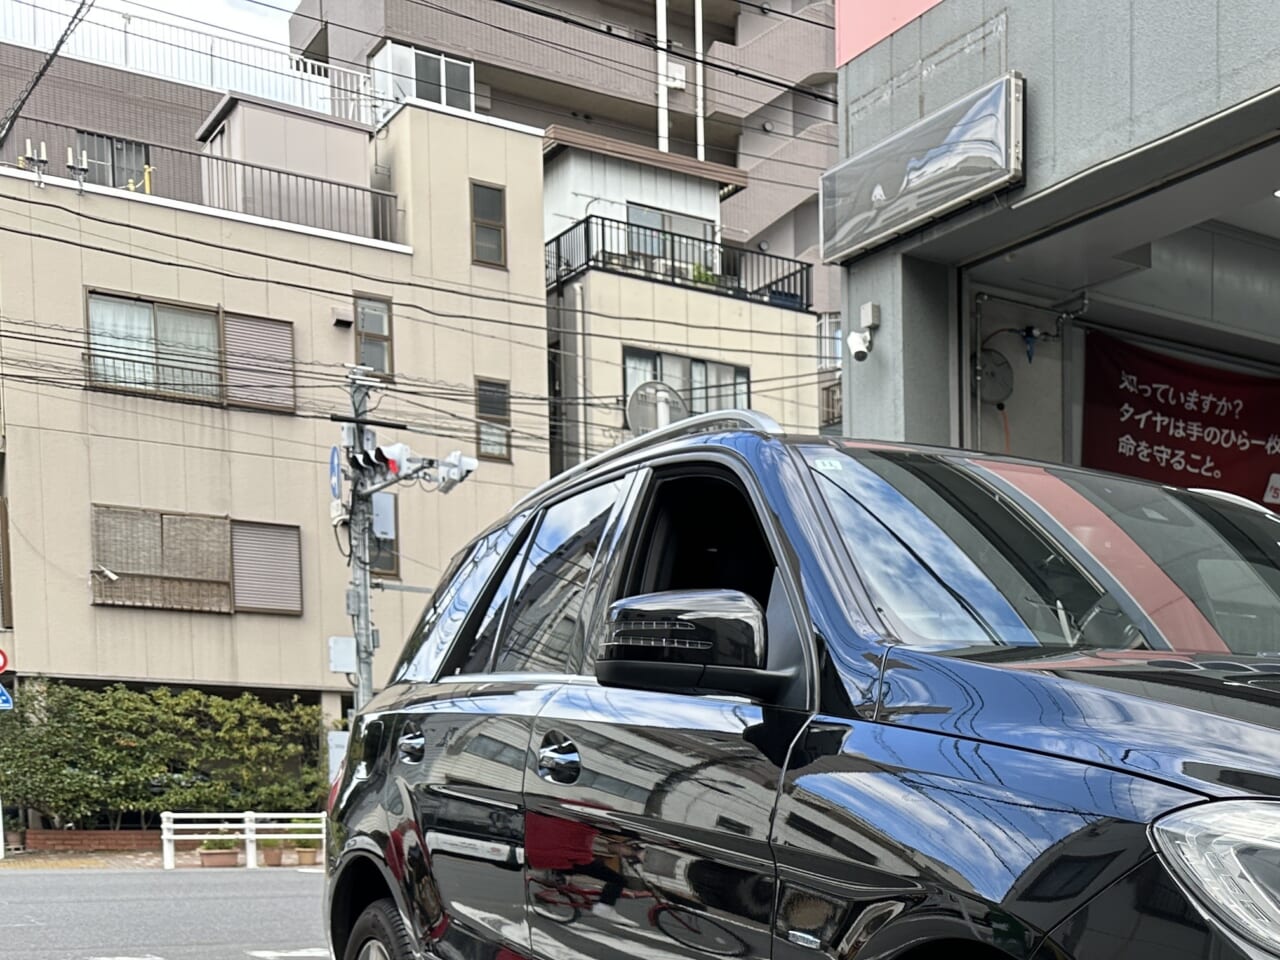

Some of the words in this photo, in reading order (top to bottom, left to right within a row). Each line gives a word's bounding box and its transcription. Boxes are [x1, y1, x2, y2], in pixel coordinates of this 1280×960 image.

[1118, 434, 1222, 479] 命を守ること。
